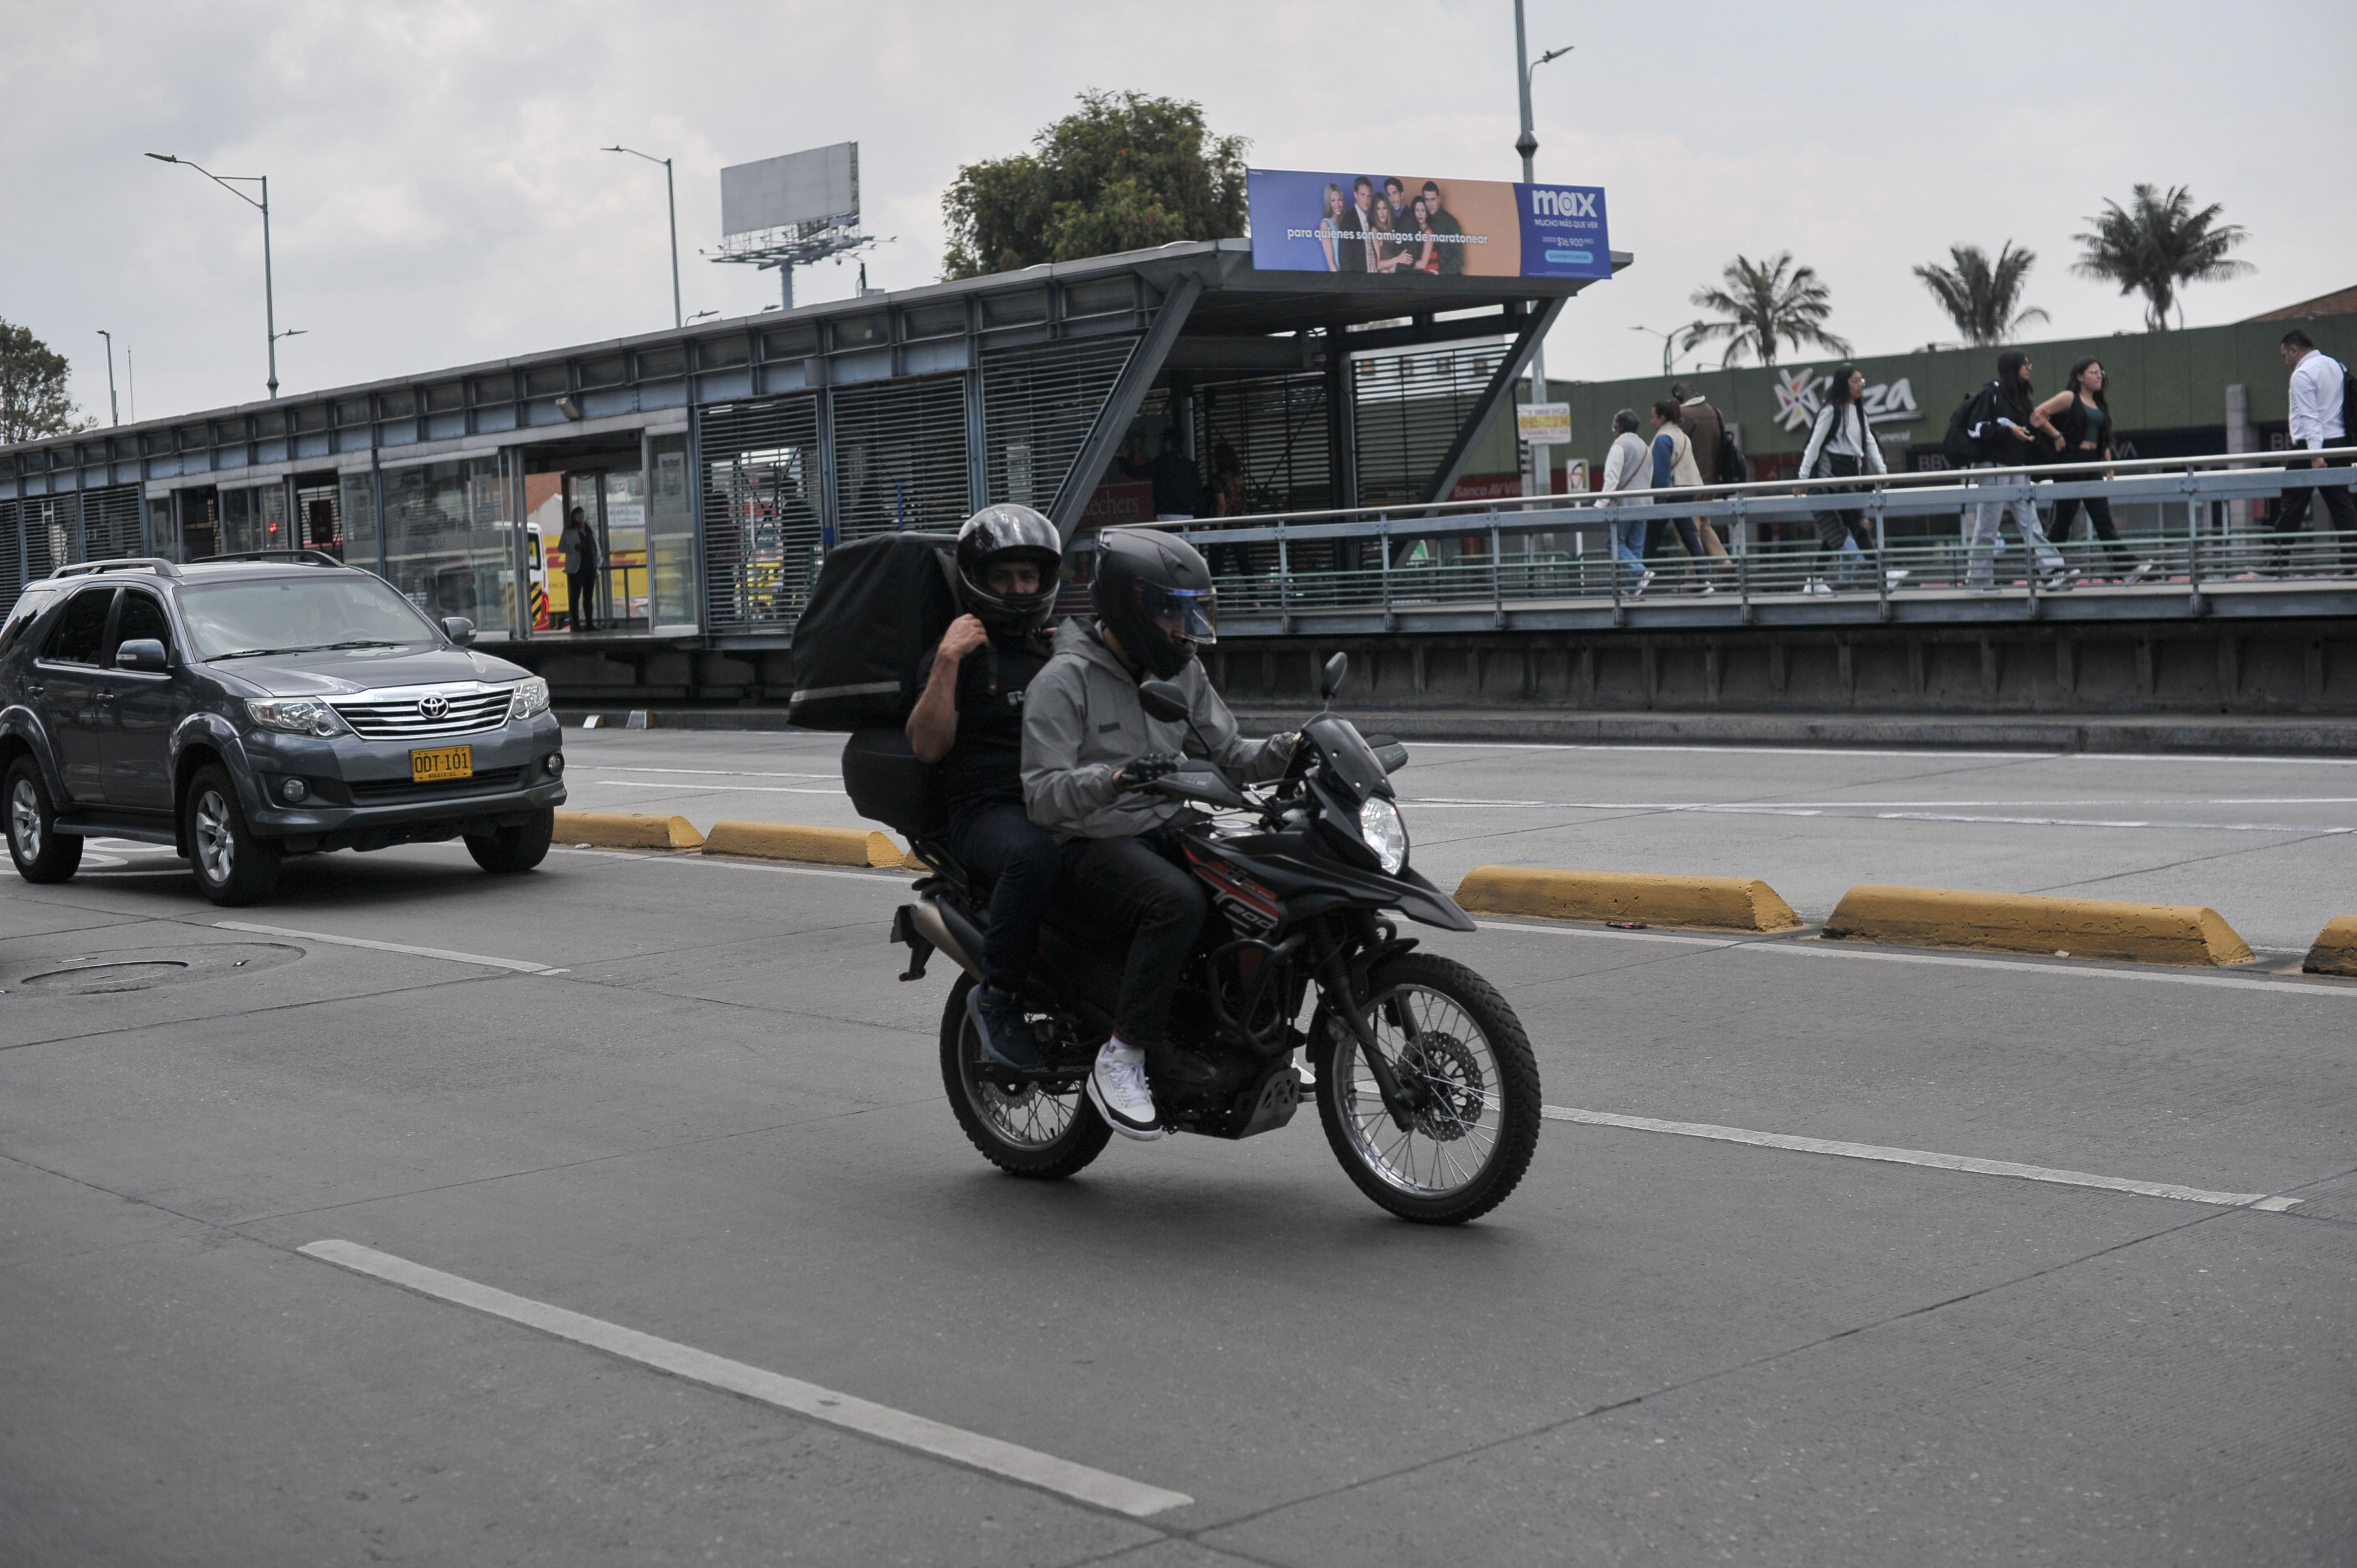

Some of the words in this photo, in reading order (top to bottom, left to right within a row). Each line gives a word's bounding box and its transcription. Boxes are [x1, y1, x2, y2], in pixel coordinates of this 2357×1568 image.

[1532, 190, 1597, 218] max
[1534, 219, 1558, 227] MUCHO
[1560, 218, 1573, 228] MÁS
[1287, 228, 1313, 240] para
[1314, 228, 1355, 240] quienes
[1356, 231, 1375, 239] son
[1376, 230, 1413, 244] amigos
[1414, 230, 1428, 241] de
[1429, 233, 1488, 244] maratonear
[1454, 485, 1489, 498] Banco
[445, 752, 469, 770] 101
[1227, 903, 1275, 929] 200
